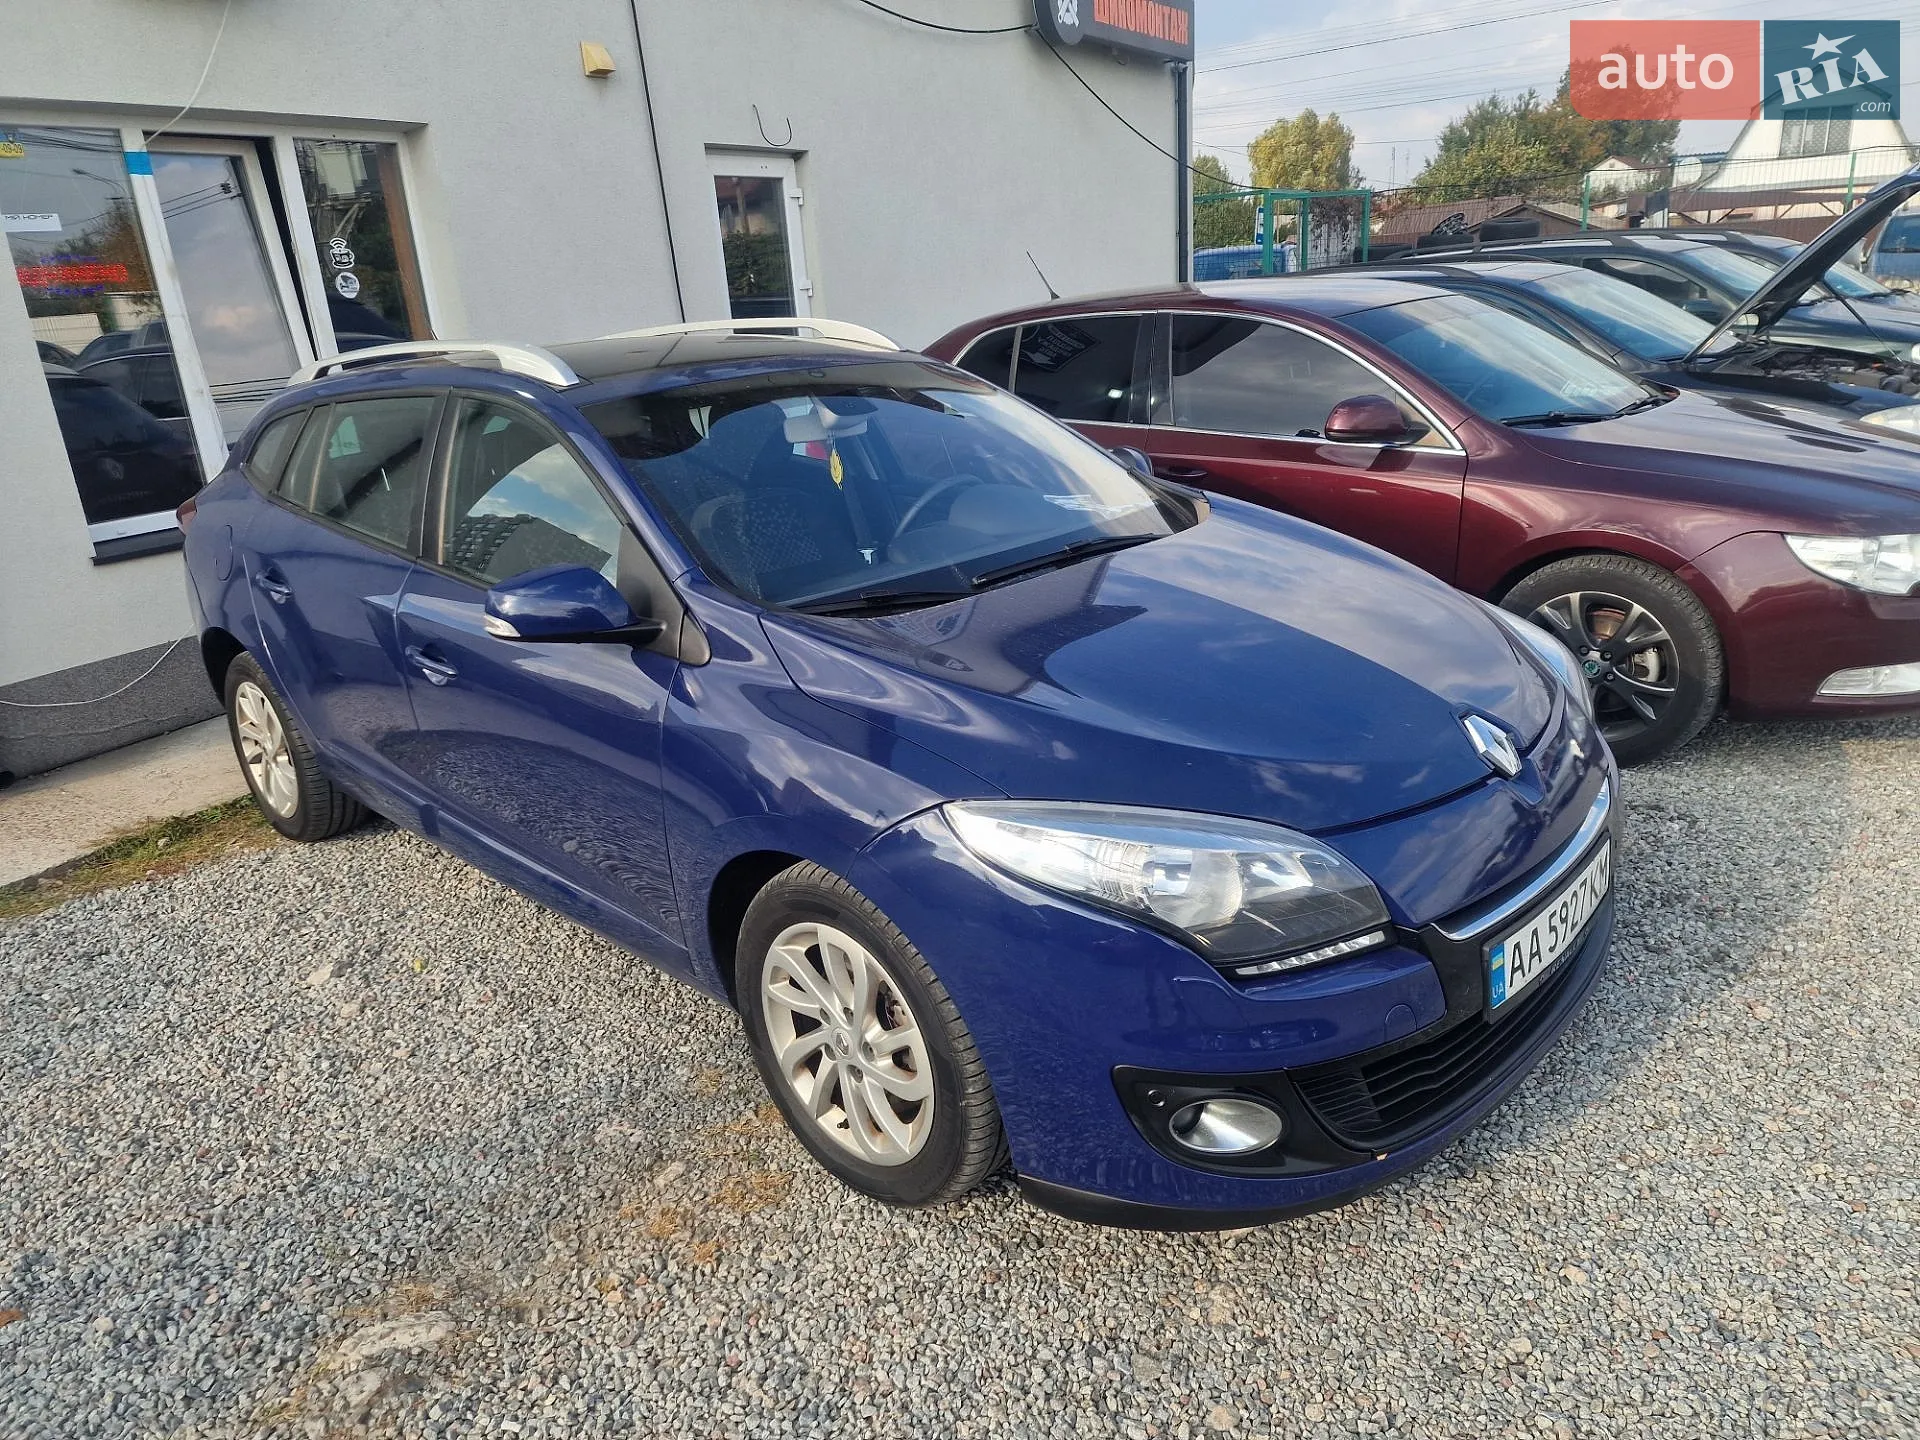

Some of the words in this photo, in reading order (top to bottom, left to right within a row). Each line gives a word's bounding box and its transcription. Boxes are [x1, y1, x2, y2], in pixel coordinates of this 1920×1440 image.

[1509, 926, 1543, 988] AA
[1547, 877, 1588, 953] 5927
[1491, 983, 1506, 999] UA
